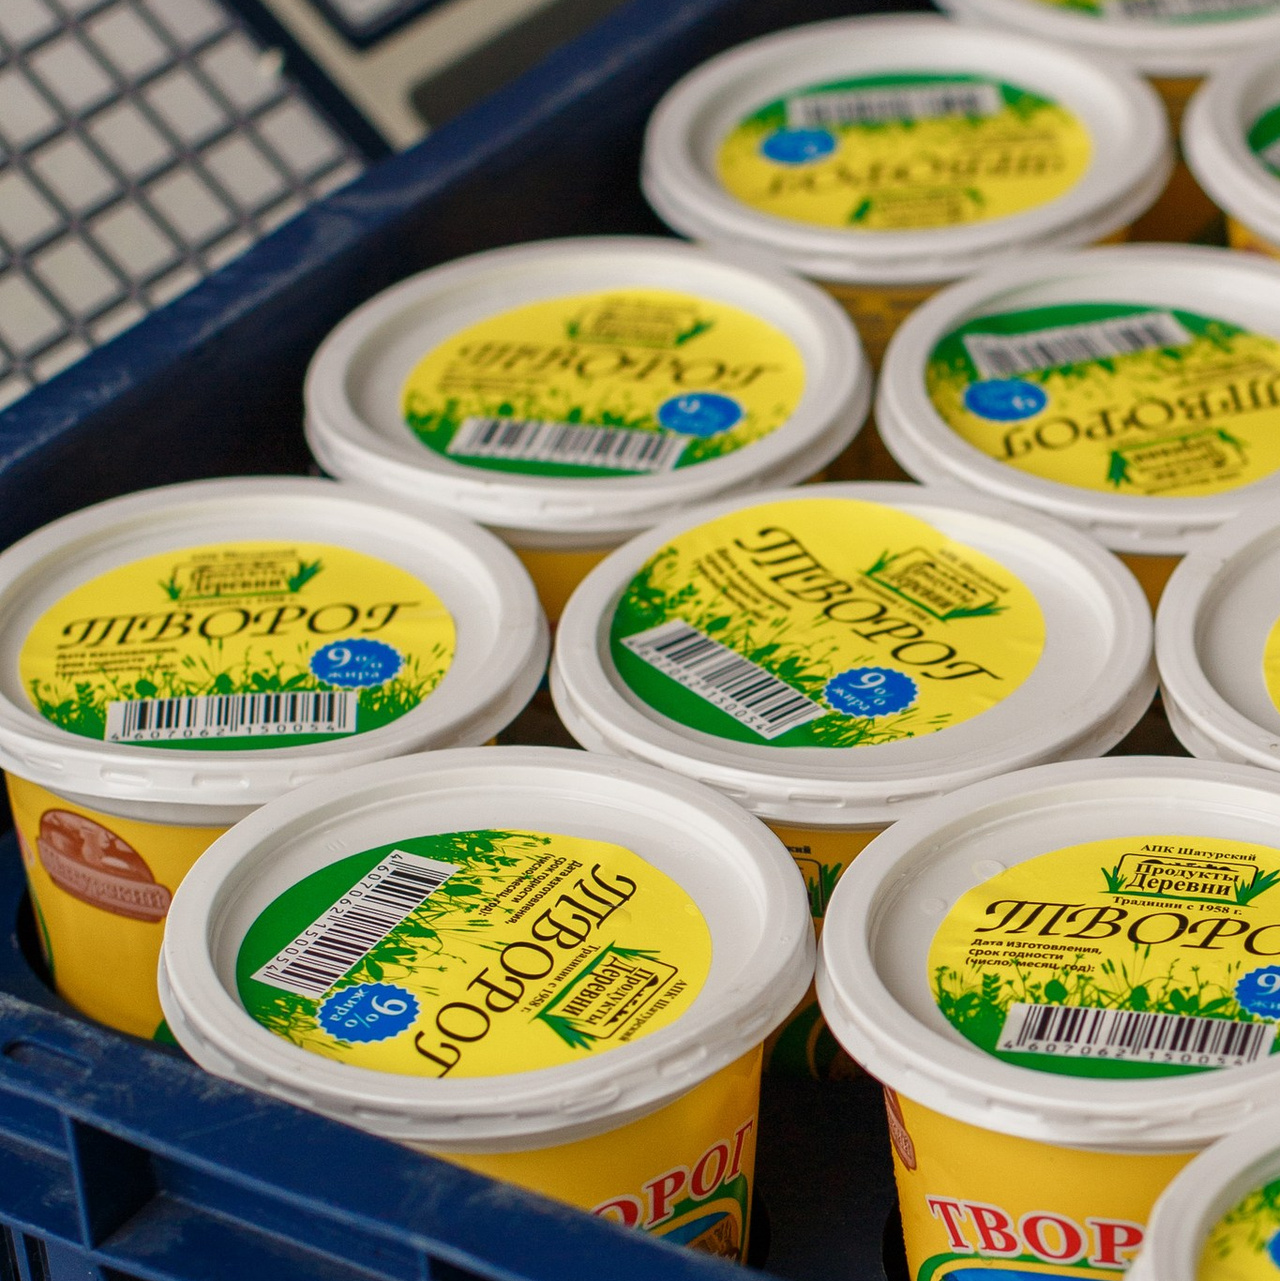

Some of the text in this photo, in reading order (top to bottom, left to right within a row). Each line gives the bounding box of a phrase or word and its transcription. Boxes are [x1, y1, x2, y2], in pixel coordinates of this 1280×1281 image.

[733, 526, 1005, 682] ТВОРОГ
[56, 602, 420, 648] ТВОРОГ
[1140, 844, 1257, 862] АПК Шатурский
[511, 856, 568, 904] срок годности
[1124, 873, 1233, 897] Деревни
[1135, 863, 1240, 883] Продукты
[504, 859, 584, 925] Дата изготовления,
[1112, 896, 1183, 910] Традиции
[1199, 904, 1231, 915] 1958
[968, 948, 1064, 961] срок годности
[970, 938, 1103, 956] Дата изготовления,
[413, 864, 638, 1078] ТВОРОГ
[554, 944, 601, 982] Традиции
[965, 956, 1096, 973] (число, месяц, год):
[528, 988, 554, 1009] 1958
[562, 954, 639, 1017] Деревни
[585, 968, 655, 1025] Продукты
[663, 980, 688, 1000] АПК
[329, 988, 370, 1023] жира
